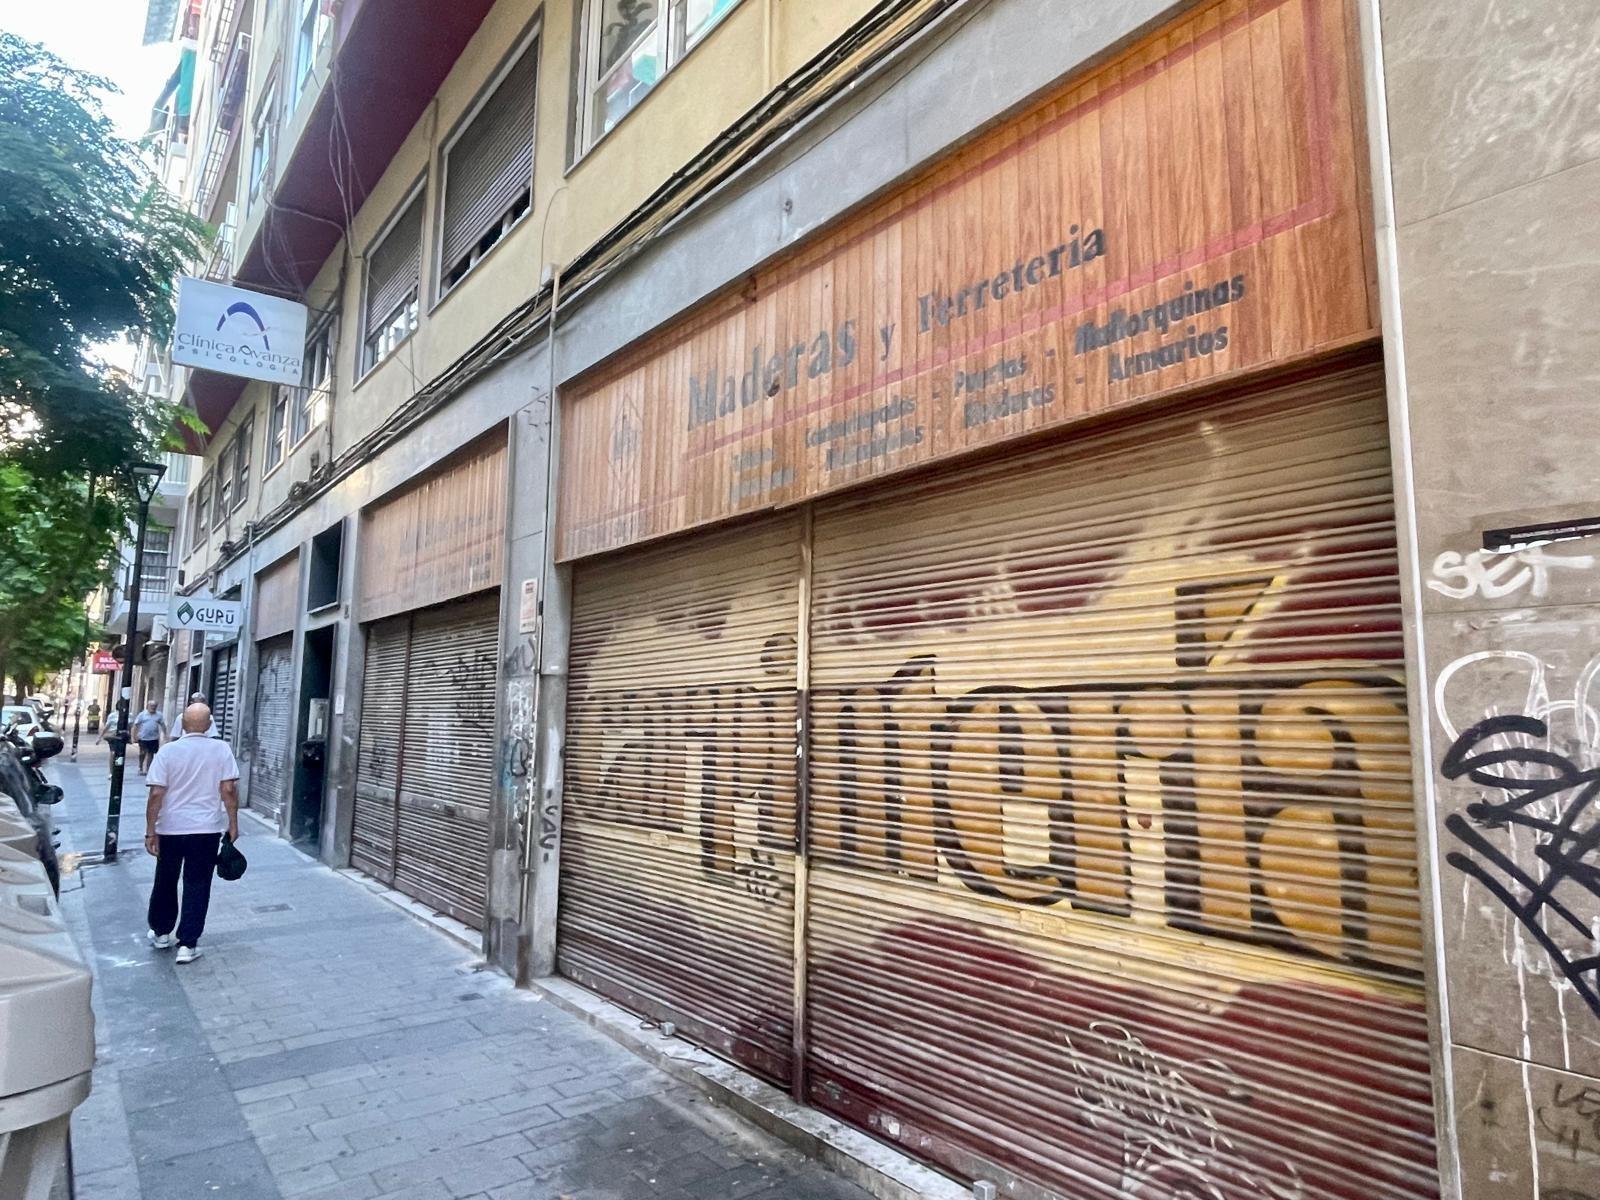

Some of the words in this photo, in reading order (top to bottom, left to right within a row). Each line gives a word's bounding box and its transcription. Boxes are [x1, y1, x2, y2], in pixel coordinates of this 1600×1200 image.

[177, 332, 235, 354] Clínica
[238, 344, 301, 367] Avanza
[688, 319, 856, 432] Maderas
[879, 322, 896, 362] y
